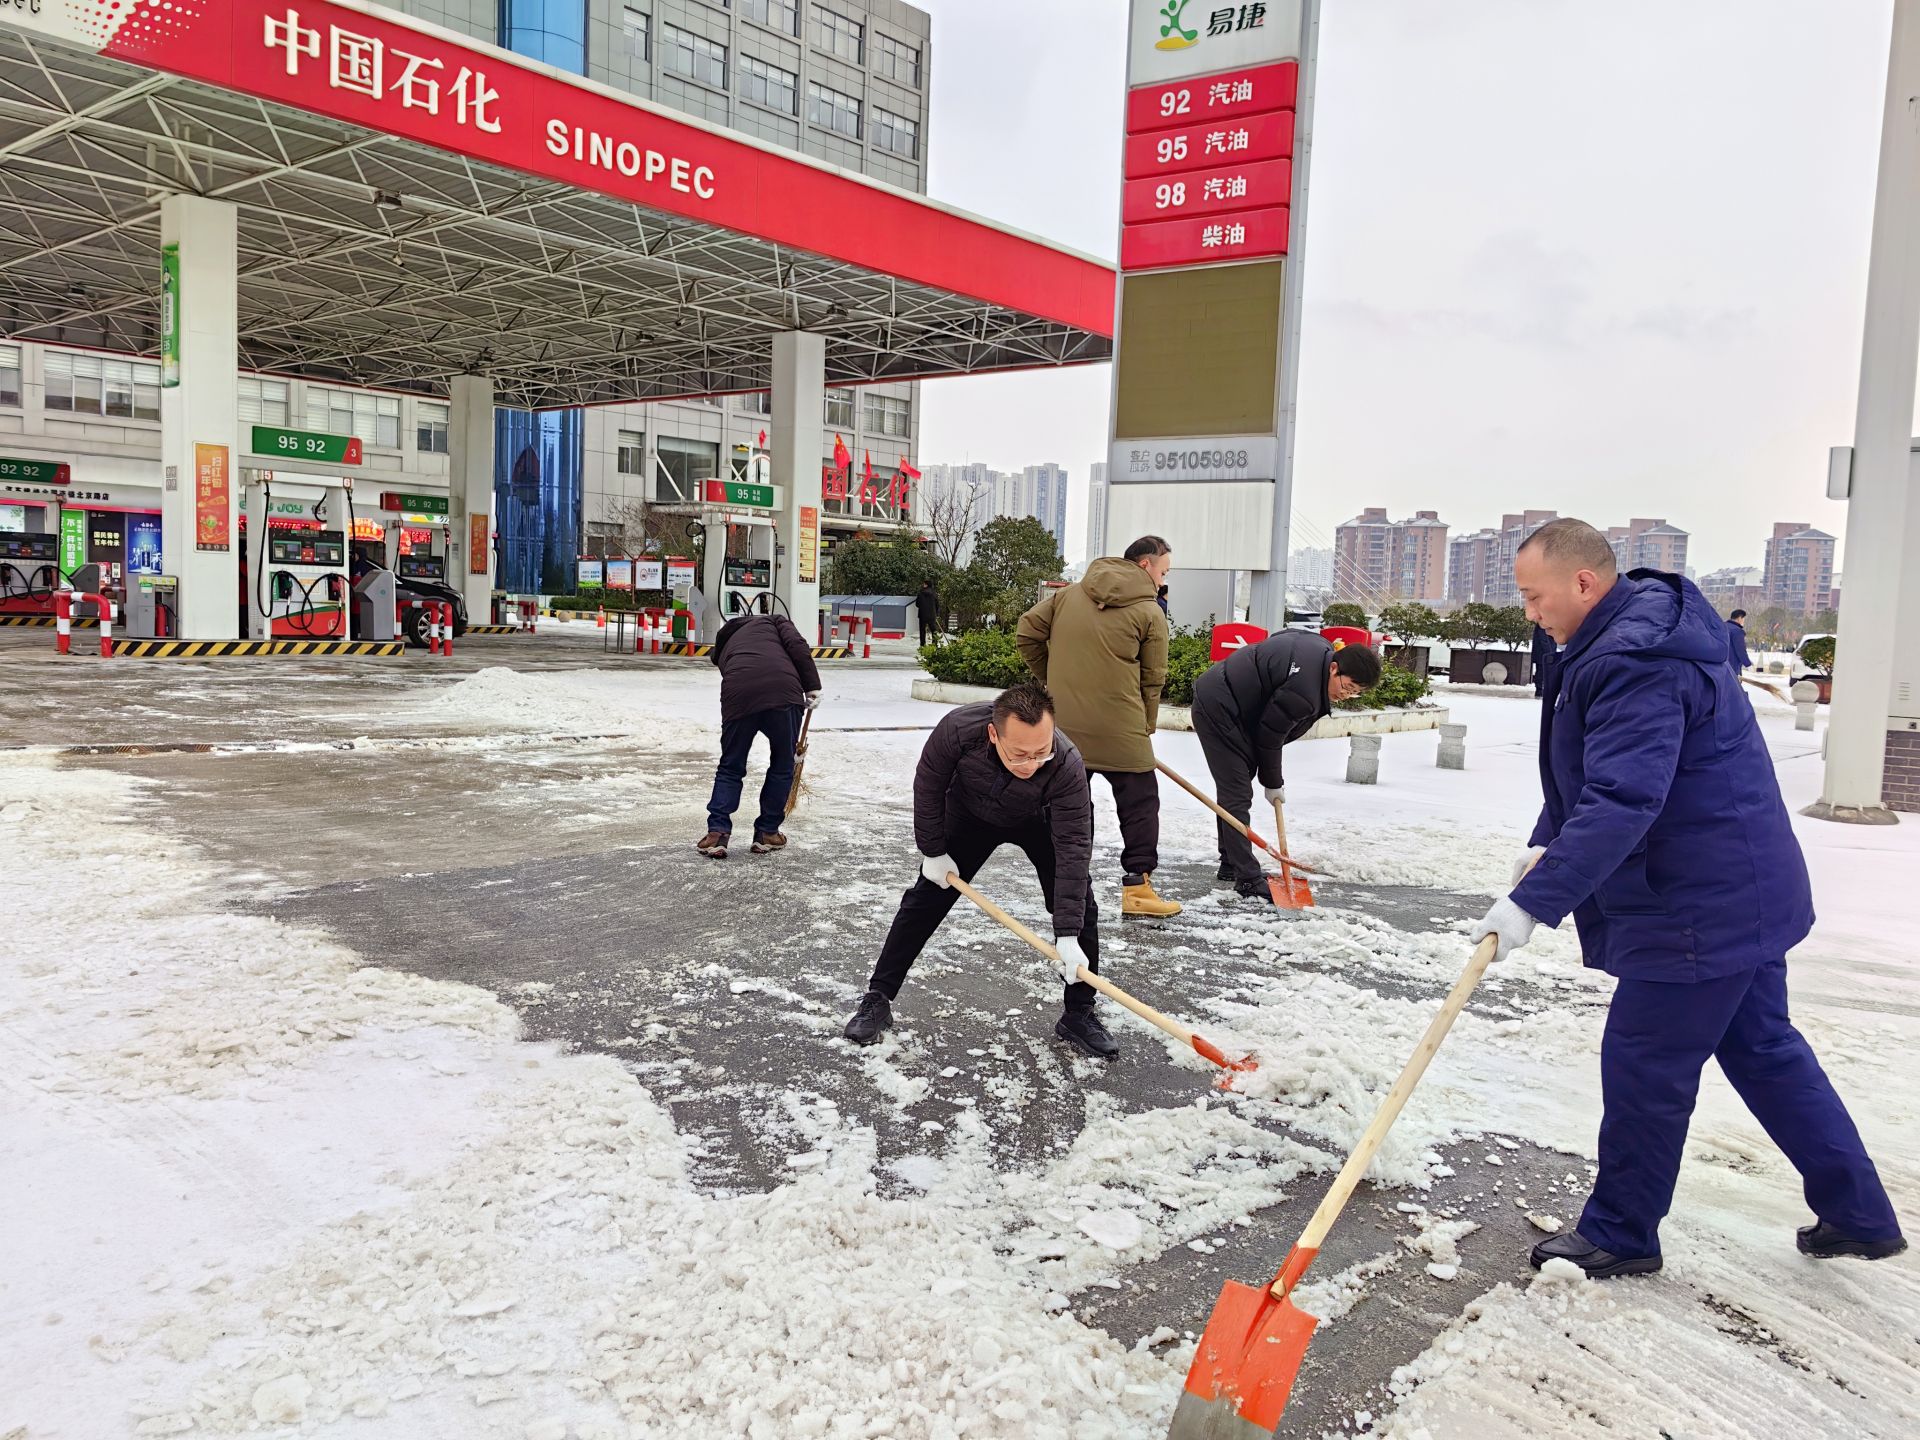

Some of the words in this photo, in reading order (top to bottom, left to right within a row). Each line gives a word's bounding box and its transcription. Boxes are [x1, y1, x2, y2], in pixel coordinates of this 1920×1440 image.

[1207, 2, 1266, 37] 易捷
[264, 9, 502, 134] 中国石化
[1160, 90, 1191, 116] 92
[1208, 79, 1253, 106] 汽油
[1157, 136, 1187, 163] 95
[1205, 128, 1249, 154] 汽油
[545, 119, 714, 199] SINOPEC
[1155, 182, 1186, 209] 98
[1203, 175, 1247, 201] 汽油
[1202, 222, 1245, 248] 柴油
[278, 435, 298, 450] 95
[306, 438, 326, 454] 92
[351, 448, 357, 457] 3
[1130, 450, 1150, 461] 客户
[1155, 450, 1248, 470] 95105988
[1, 464, 17, 475] 92
[23, 466, 39, 476] 92
[264, 470, 272, 480] 5
[345, 478, 351, 488] 6
[407, 499, 416, 507] 95
[423, 500, 432, 509] 92
[737, 489, 749, 500] 95
[277, 503, 303, 513] JOY
